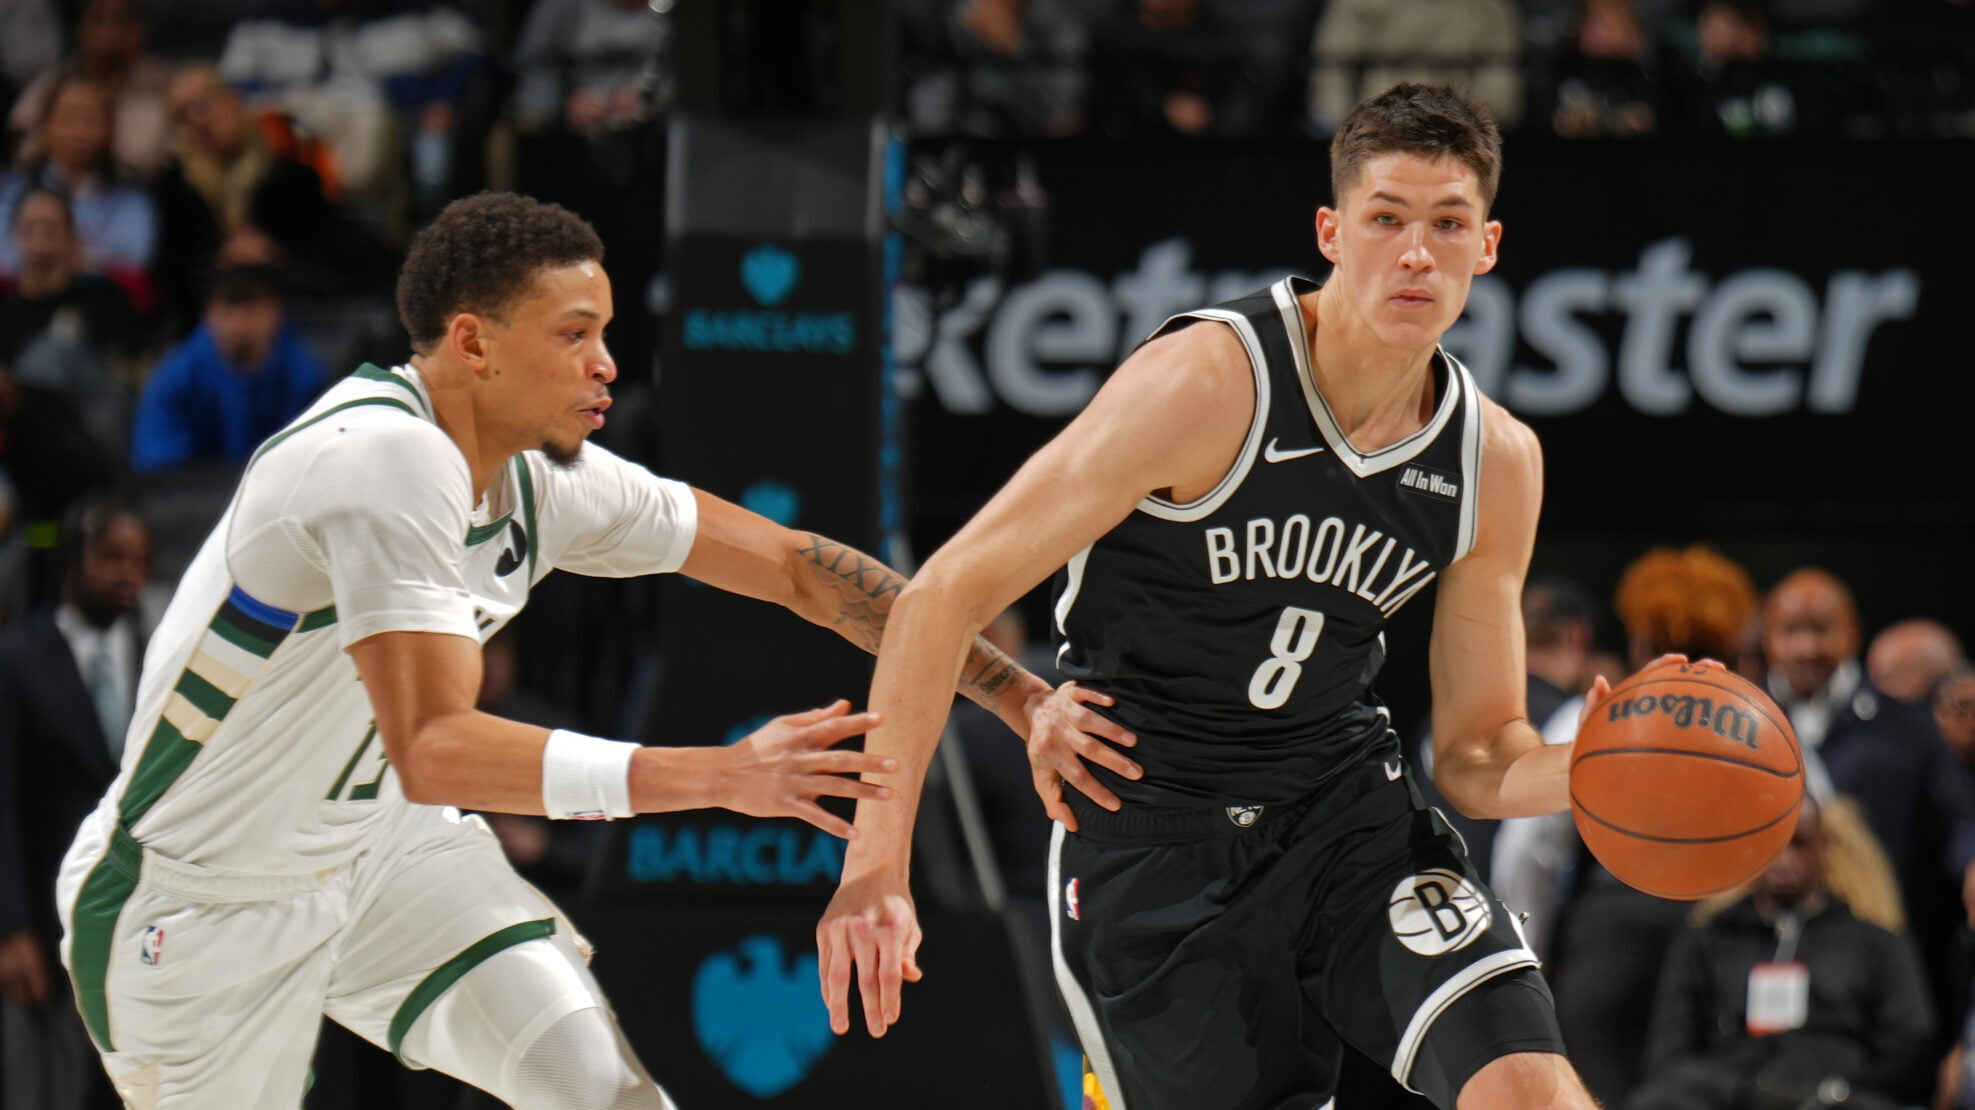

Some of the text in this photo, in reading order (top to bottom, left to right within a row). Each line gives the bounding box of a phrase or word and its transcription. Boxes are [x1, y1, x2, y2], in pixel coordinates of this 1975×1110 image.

[684, 310, 855, 353] BARCLAYS
[1400, 467, 1458, 498] All In Won
[1248, 606, 1324, 710] 8
[1608, 694, 1759, 750] Wilson
[628, 825, 849, 885] BARCLA
[1414, 880, 1467, 942] B
